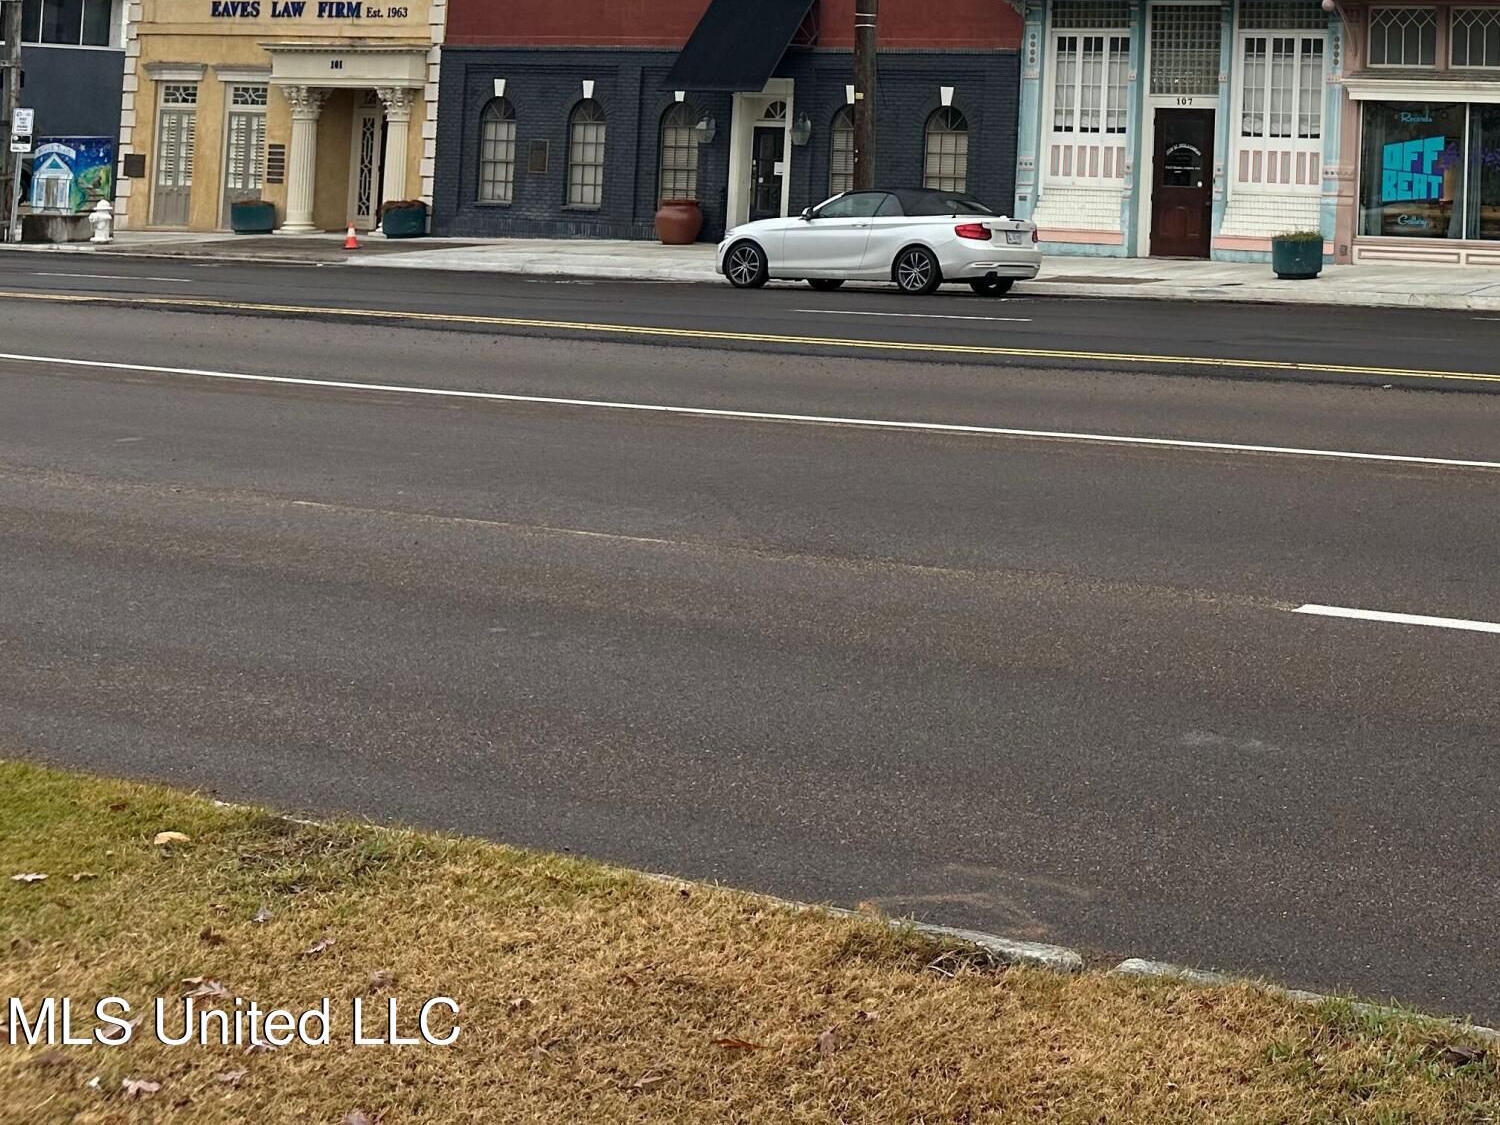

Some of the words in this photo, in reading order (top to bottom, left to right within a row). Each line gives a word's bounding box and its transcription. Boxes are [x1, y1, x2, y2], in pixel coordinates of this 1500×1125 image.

[211, 0, 260, 18] EAVES
[271, 0, 306, 18] LAW
[317, 1, 362, 18] FIRM
[366, 7, 383, 18] Est.
[387, 7, 408, 18] 1963
[330, 60, 343, 69] 101
[1383, 136, 1445, 174] OFF
[1382, 169, 1443, 202] BEAT
